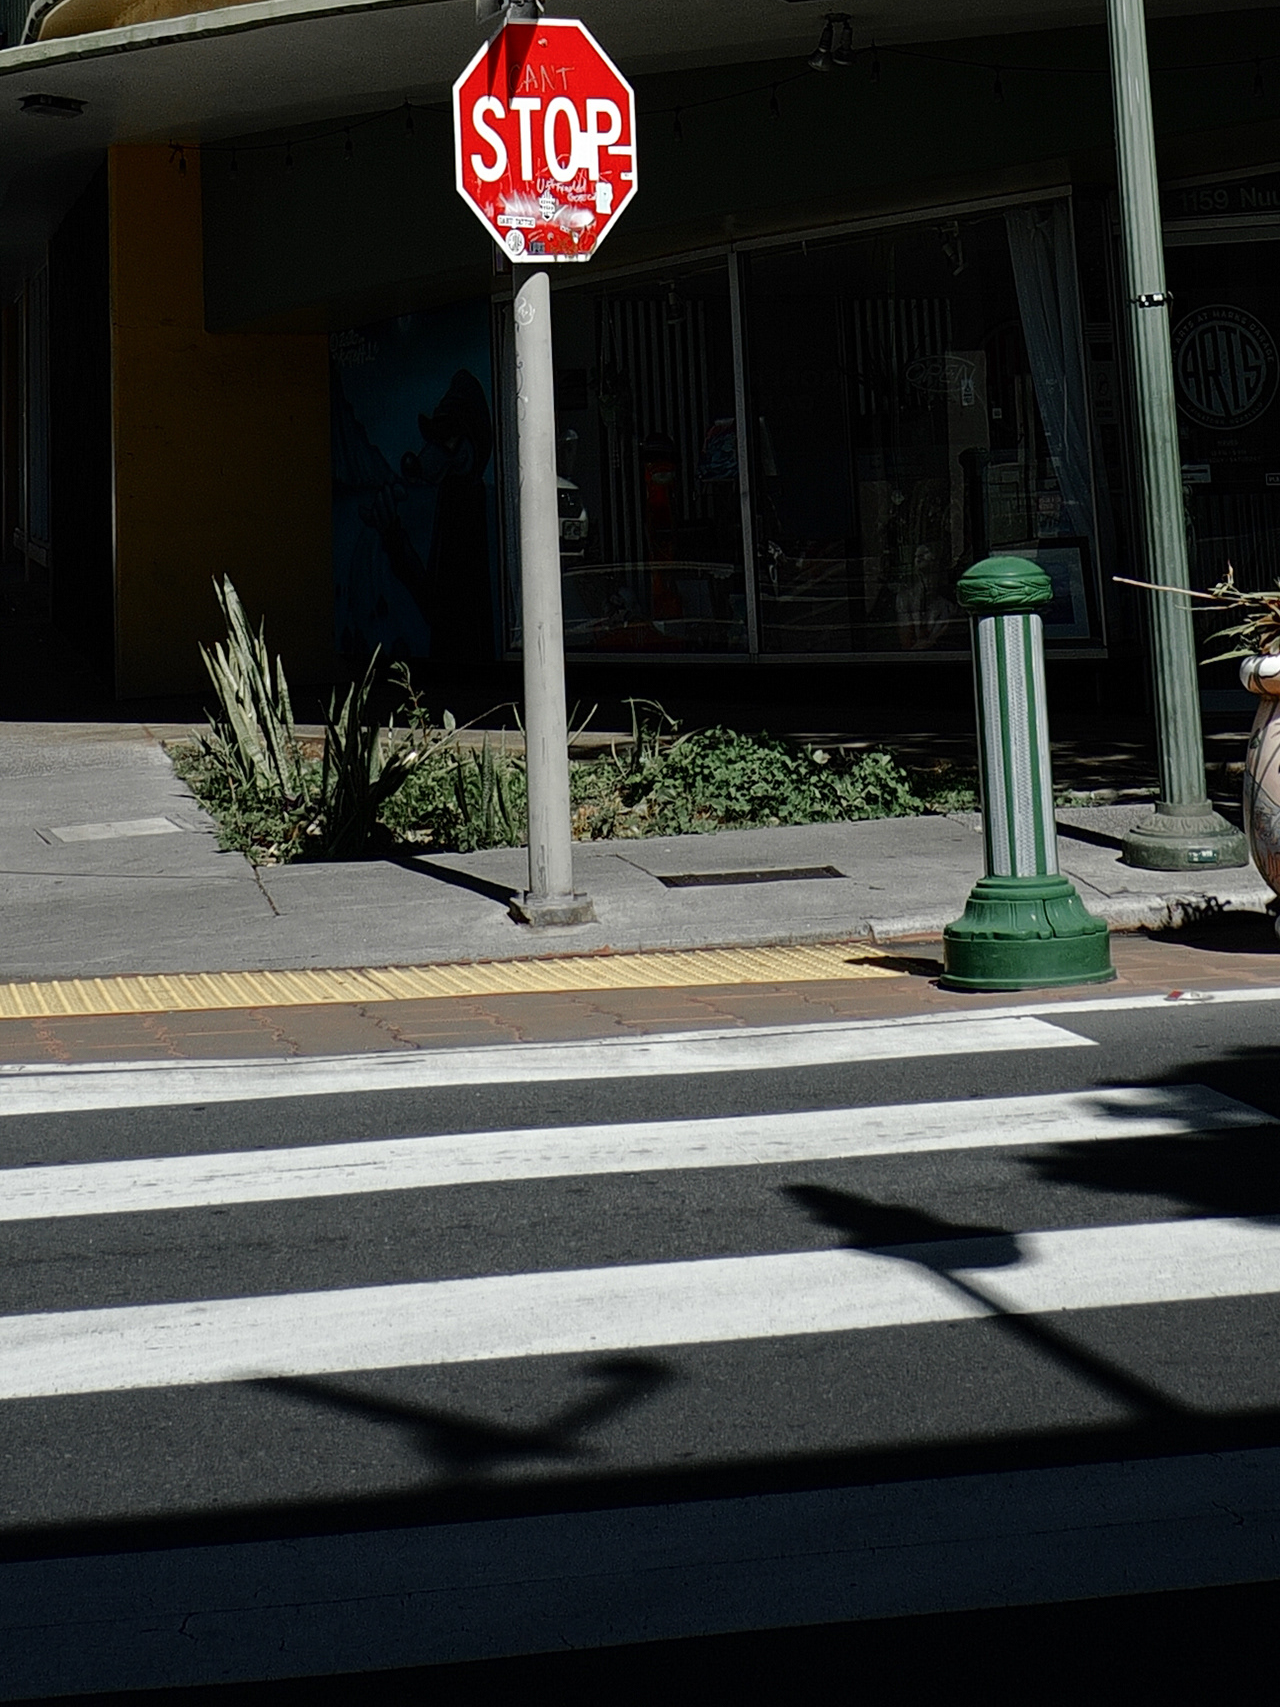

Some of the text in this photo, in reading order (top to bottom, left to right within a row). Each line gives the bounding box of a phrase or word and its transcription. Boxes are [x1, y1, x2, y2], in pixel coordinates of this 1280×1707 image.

[470, 95, 623, 183] STOP
[1181, 188, 1230, 212] 1159
[1175, 319, 1195, 344] ARTS
[1197, 311, 1208, 322] AT
[1212, 309, 1248, 325] MARKS
[905, 362, 977, 384] OPEN
[1181, 324, 1263, 417] ARTS
